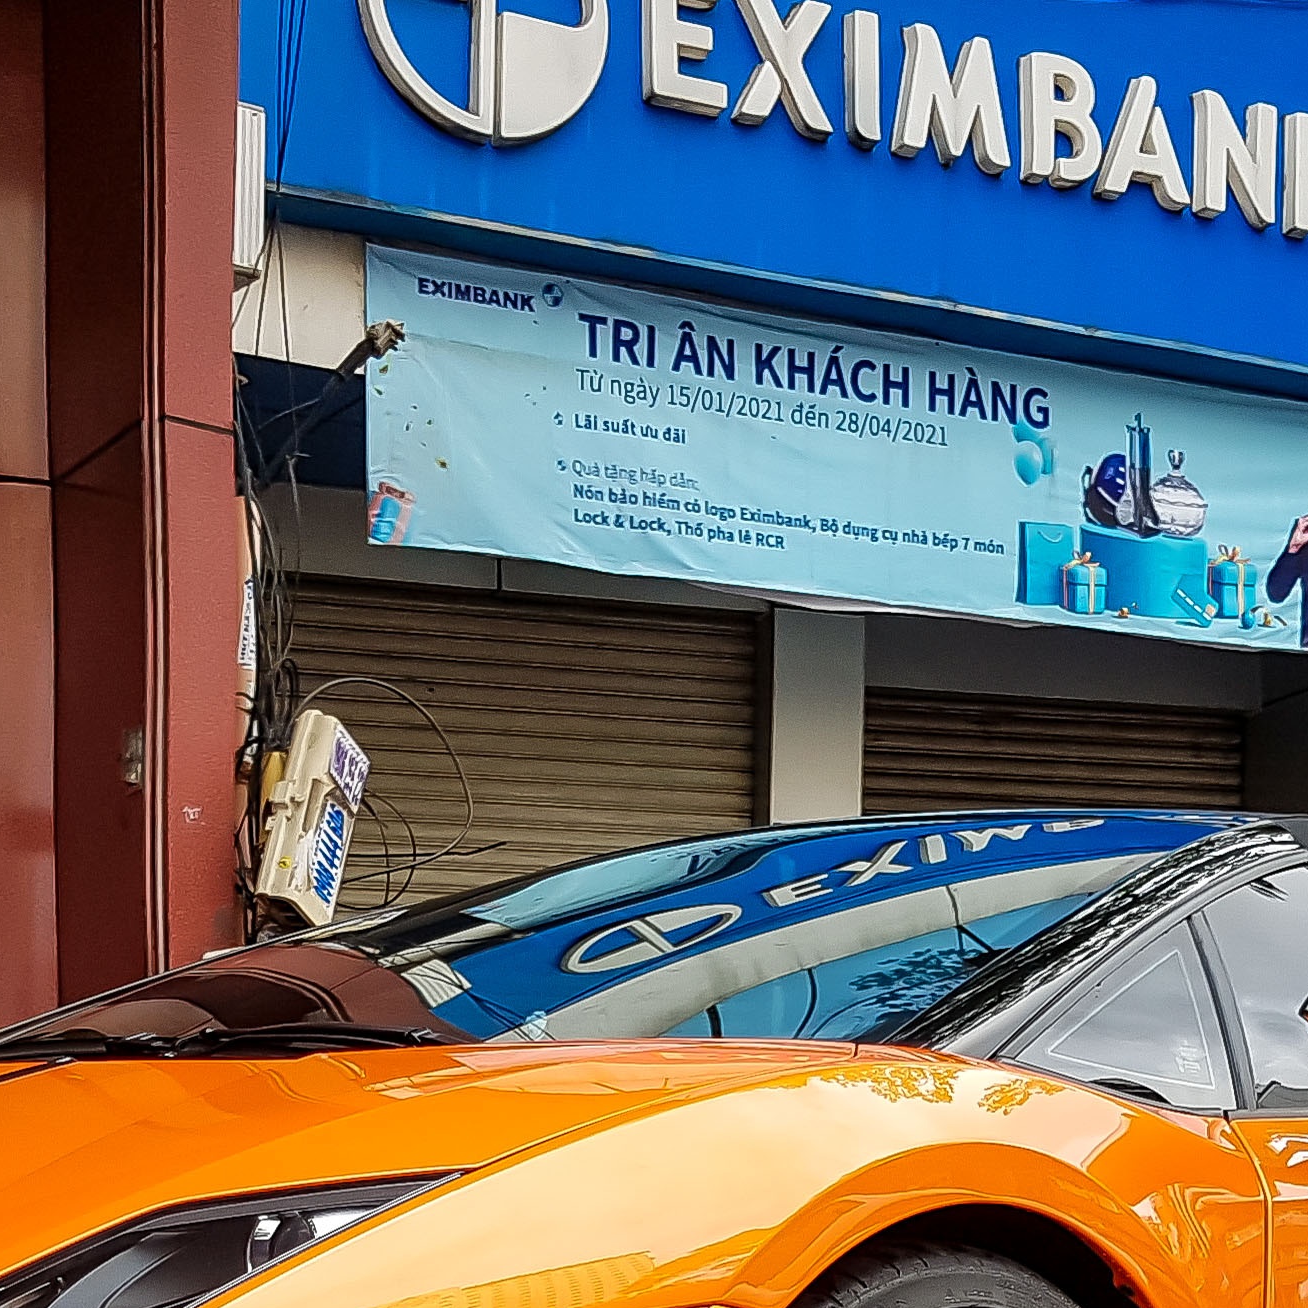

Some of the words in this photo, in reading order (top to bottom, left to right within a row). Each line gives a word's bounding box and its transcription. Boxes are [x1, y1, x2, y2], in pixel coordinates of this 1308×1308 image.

[417, 277, 535, 312] EXIMBANK
[577, 312, 658, 368] TRI
[670, 320, 737, 381] ÂN
[753, 344, 910, 409] KHÁCH
[927, 366, 1051, 430] HÀNG
[576, 368, 604, 394] Từ
[610, 377, 660, 408] ngày
[667, 383, 785, 423] 15/01/2021
[789, 402, 830, 430] đến
[835, 412, 948, 447] 28/04/2021
[574, 413, 598, 430] Lãi
[602, 418, 637, 436] suất
[640, 424, 659, 440] ưu
[662, 427, 686, 445] đãi
[571, 459, 601, 478] Quà
[573, 508, 610, 527] Lock
[613, 513, 625, 529] &
[629, 515, 672, 537] Lock,
[707, 525, 735, 543] pha
[755, 532, 786, 550] RCR
[608, 487, 639, 506] bảo
[704, 500, 737, 522] logo
[740, 506, 816, 534] Eximbank,
[842, 521, 880, 543] dụng
[902, 530, 928, 546] nhà
[932, 533, 959, 553] bếp
[962, 537, 970, 551] 7
[973, 539, 1005, 555] món
